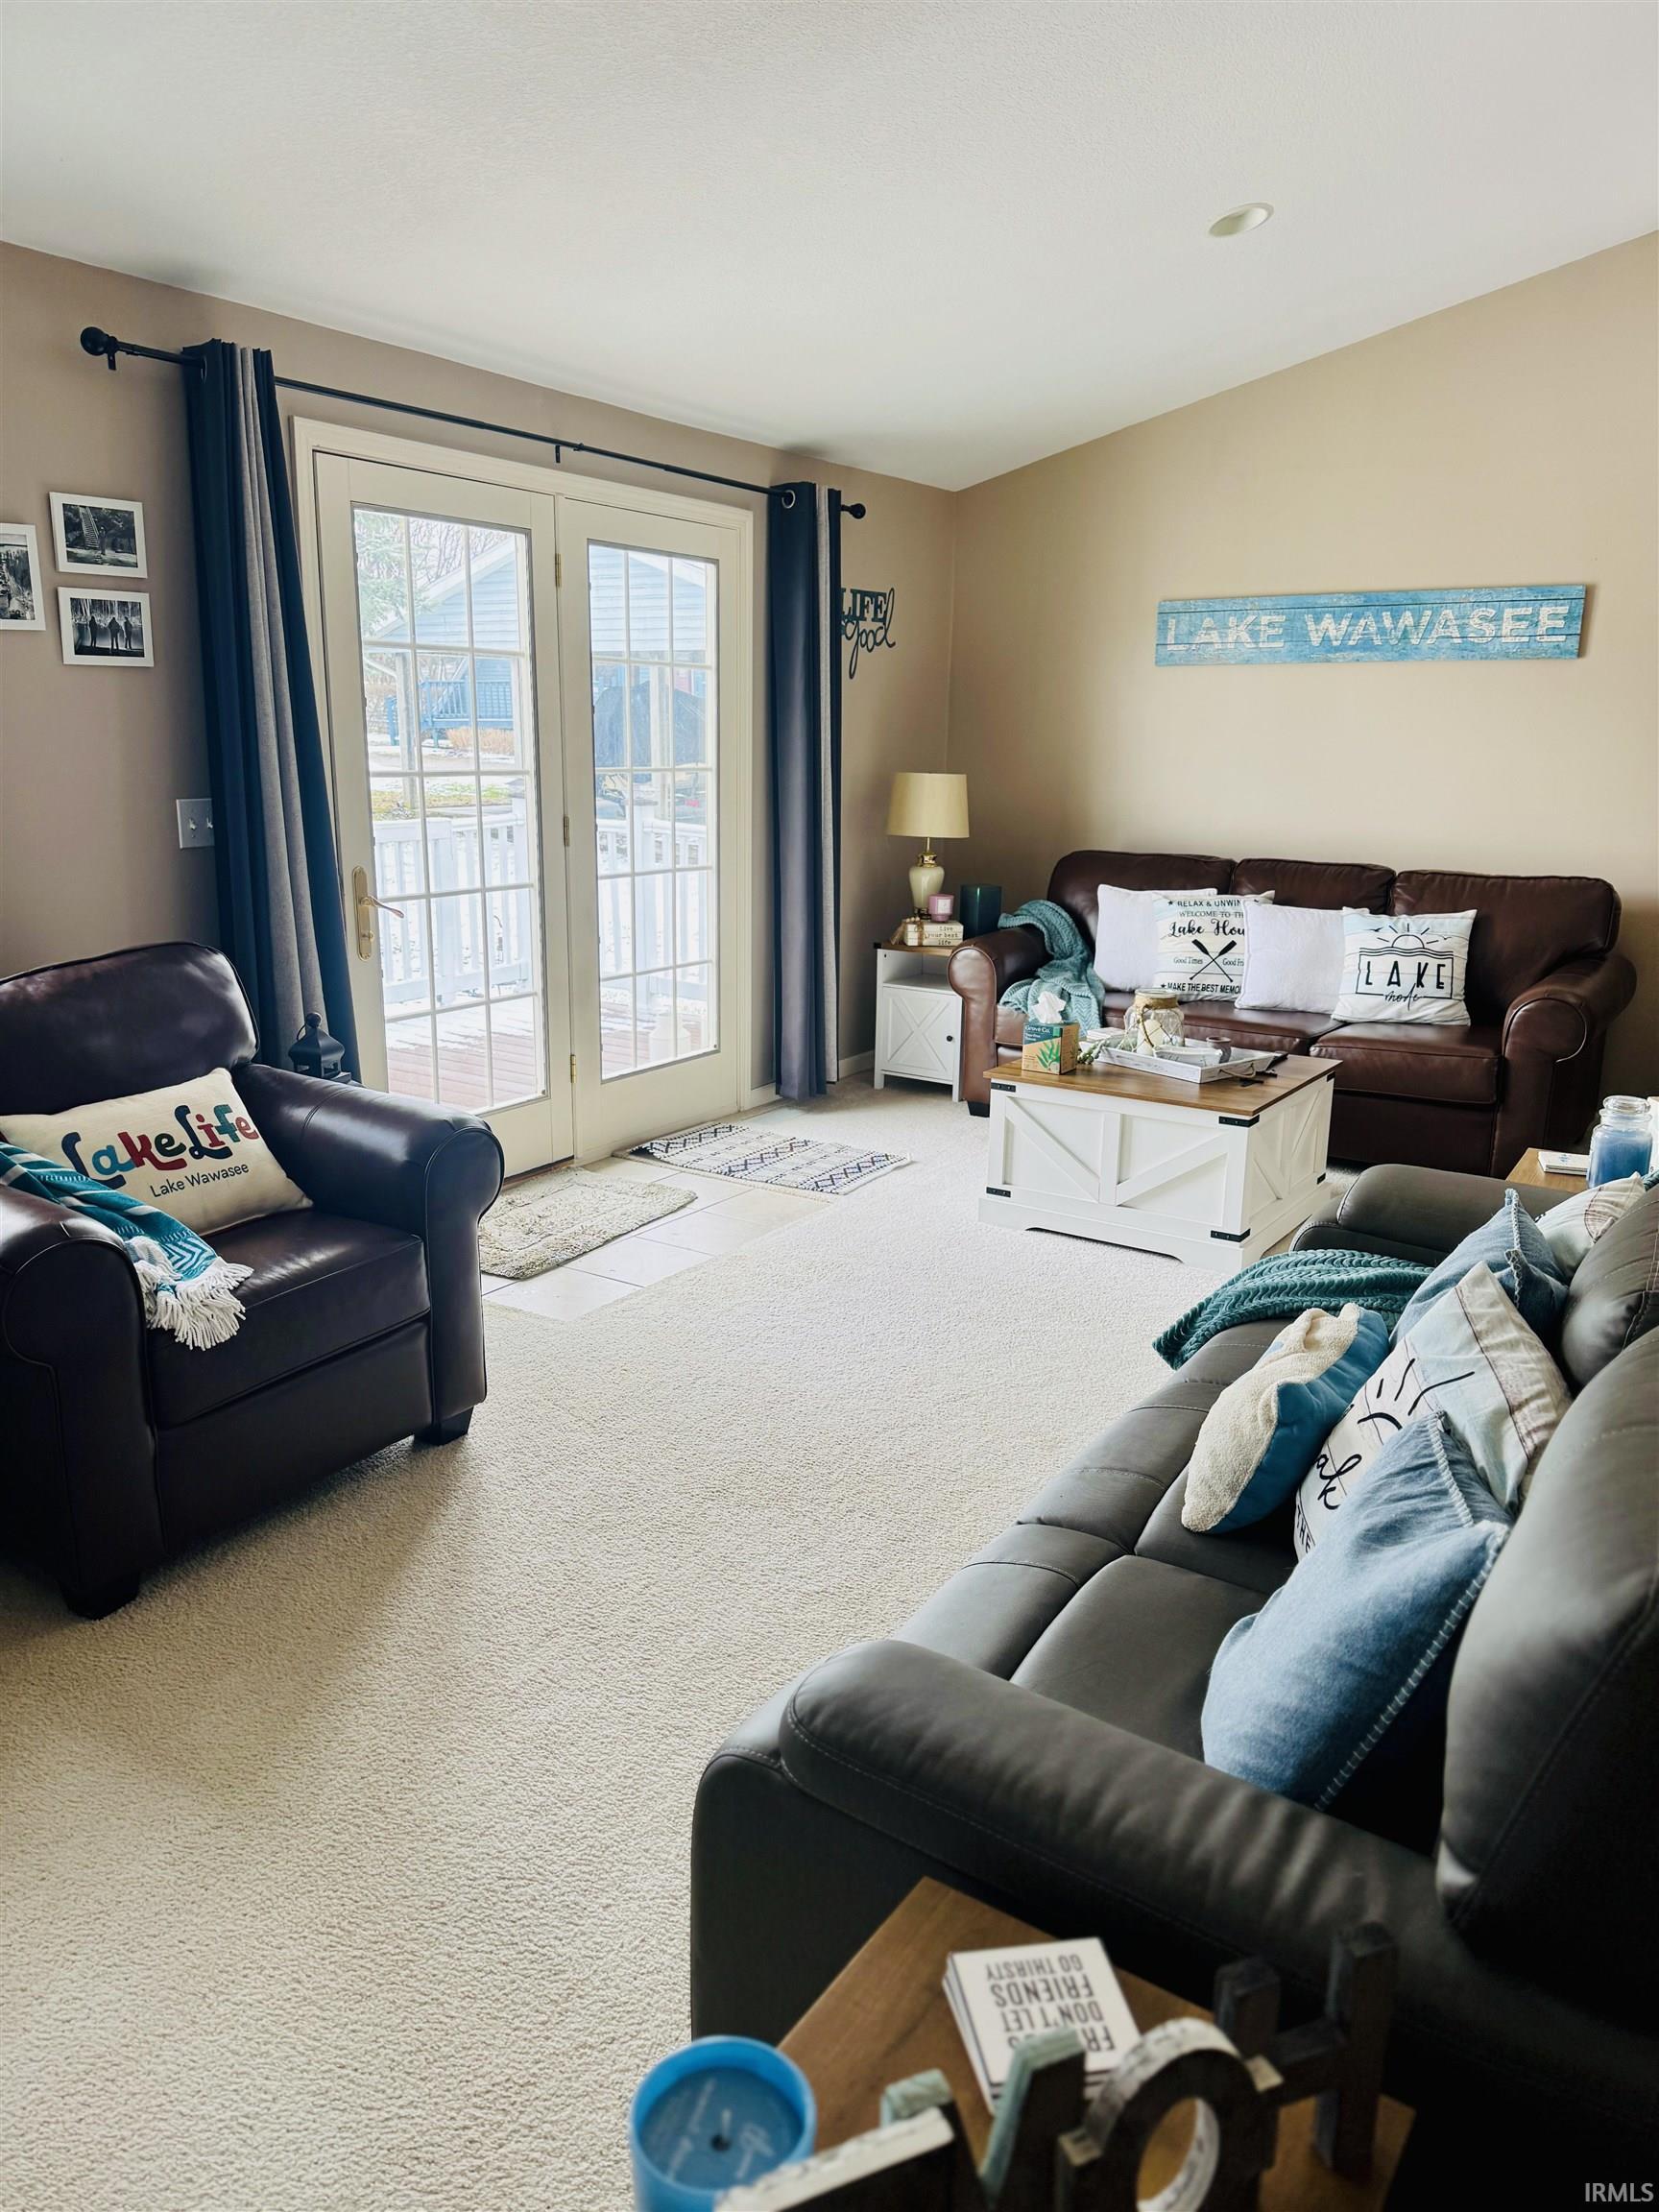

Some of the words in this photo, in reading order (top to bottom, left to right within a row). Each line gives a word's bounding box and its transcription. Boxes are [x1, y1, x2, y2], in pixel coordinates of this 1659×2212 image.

[1166, 614, 1286, 651] LAKE
[1304, 605, 1571, 646] WAWASEE
[1214, 899, 1241, 907] UNWIN
[1167, 919, 1205, 938] Lake
[1210, 918, 1245, 936] Hou
[1222, 957, 1237, 966] Good
[1365, 960, 1447, 990] LAKE
[1167, 982, 1187, 992] MAKE
[1187, 982, 1201, 992] THE
[1201, 983, 1219, 993] BEST
[150, 1180, 185, 1197] Lake
[184, 1162, 250, 1186] Wawasee
[985, 1957, 1055, 1981] THIRSTY
[1058, 1954, 1084, 1972] GO
[991, 1974, 1094, 2008] FRIENDS
[1000, 2008, 1036, 2032] LET
[1042, 2001, 1105, 2028] DON'T
